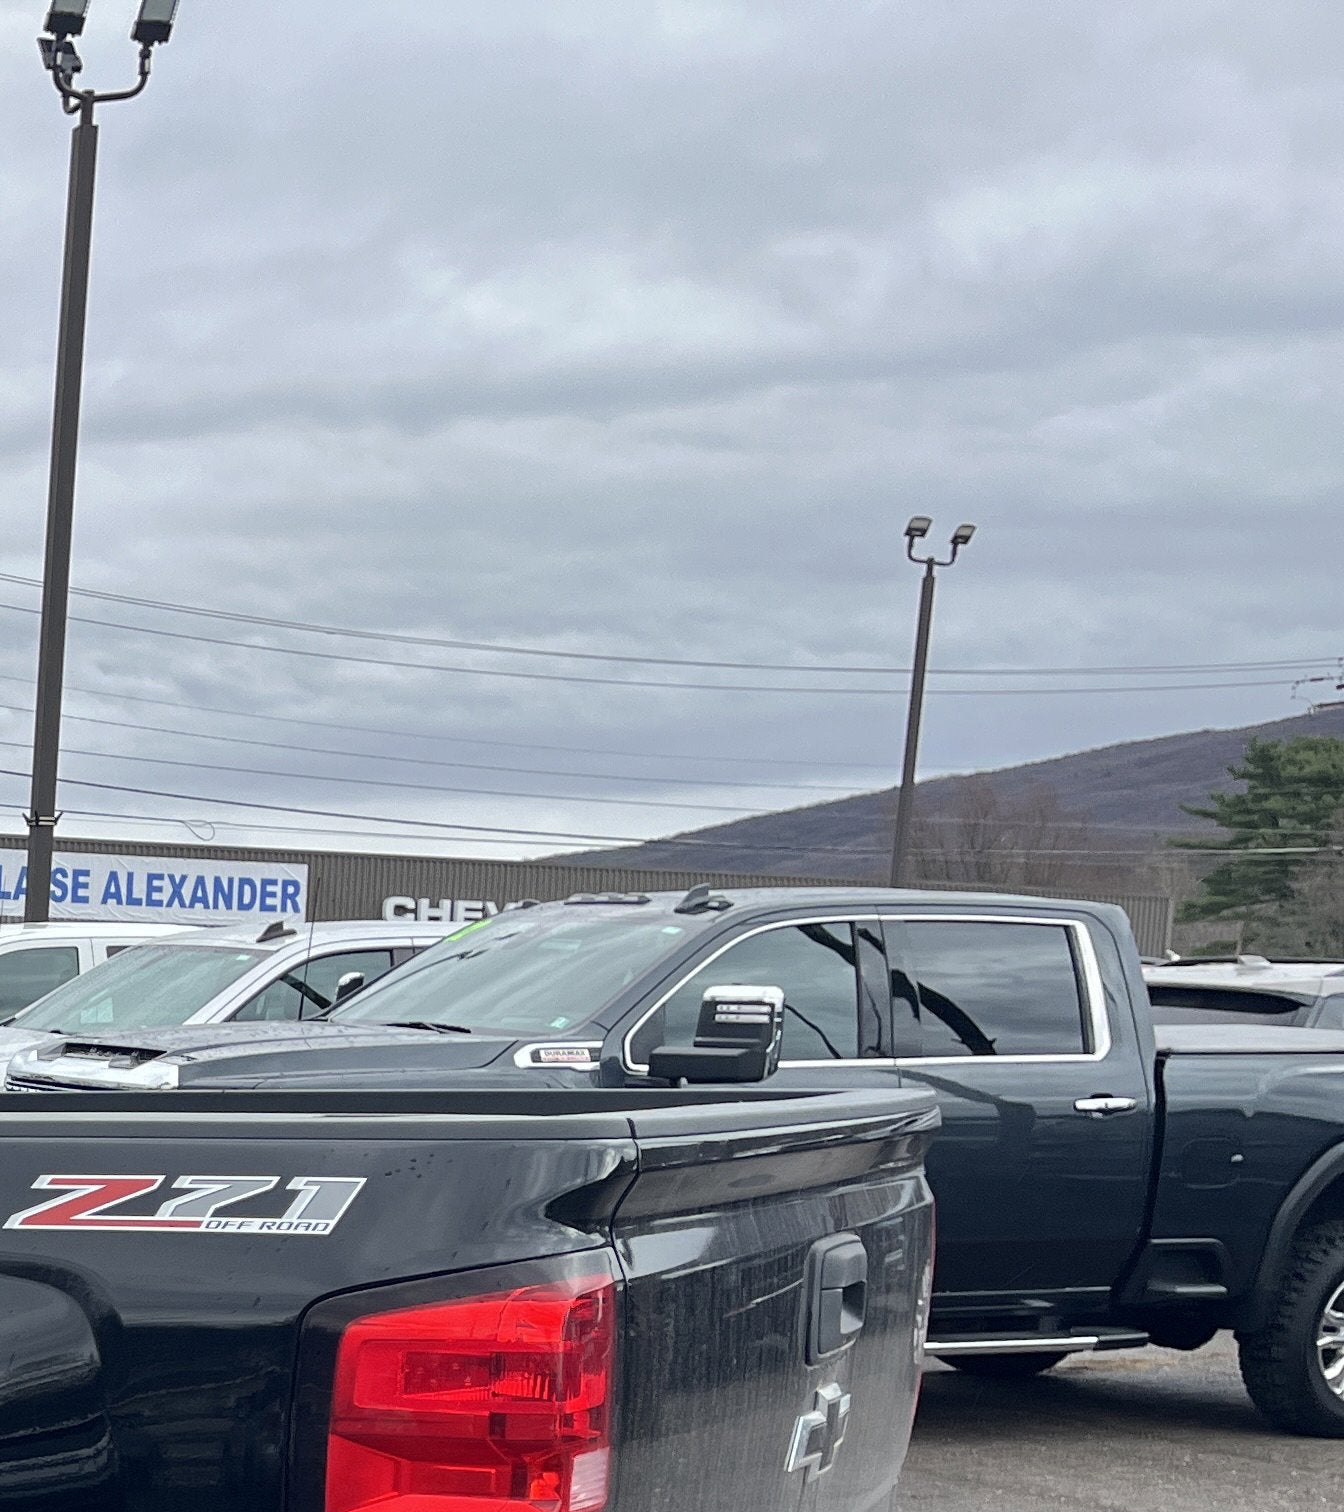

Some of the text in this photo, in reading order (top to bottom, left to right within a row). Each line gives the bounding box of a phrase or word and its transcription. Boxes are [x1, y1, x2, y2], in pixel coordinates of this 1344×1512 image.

[100, 870, 302, 914] ALEXANDER
[2, 1174, 368, 1234] Z71
[204, 1219, 331, 1232] OFF ROAD
